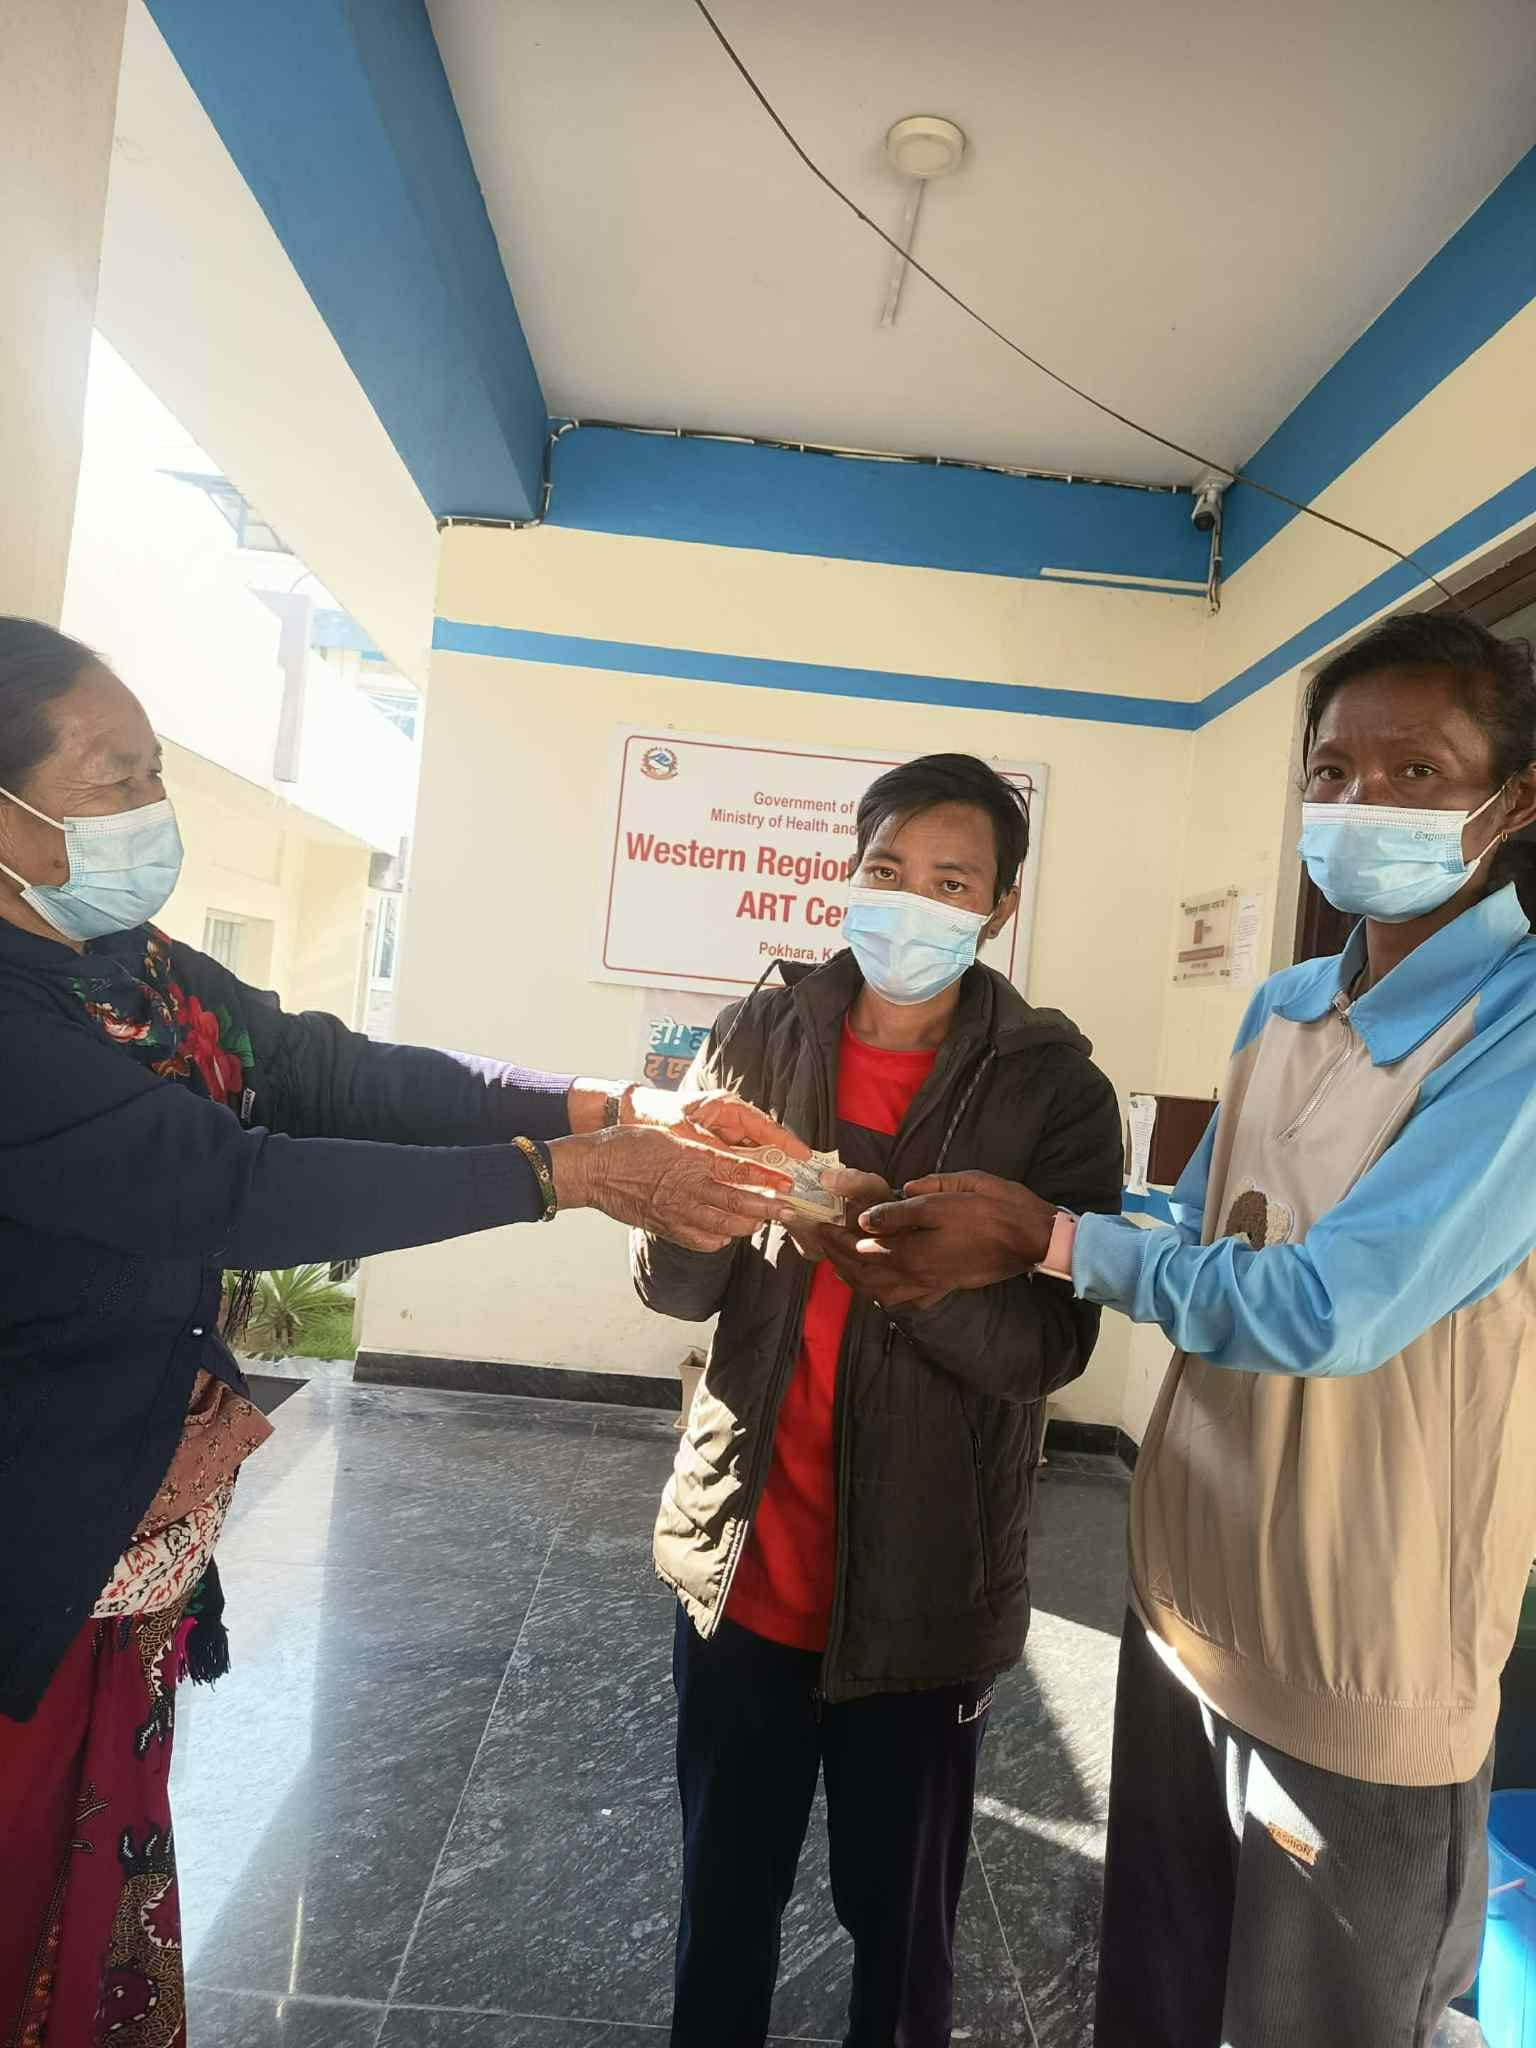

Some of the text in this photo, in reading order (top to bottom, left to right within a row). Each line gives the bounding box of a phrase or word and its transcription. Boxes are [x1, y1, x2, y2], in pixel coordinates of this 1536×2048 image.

[753, 791, 855, 815] Government of
[710, 807, 765, 830] Ministry
[768, 814, 783, 828] of
[786, 816, 829, 833] Health
[626, 832, 745, 872] Western
[736, 890, 797, 923] ART
[759, 942, 818, 960] Pokhara,
